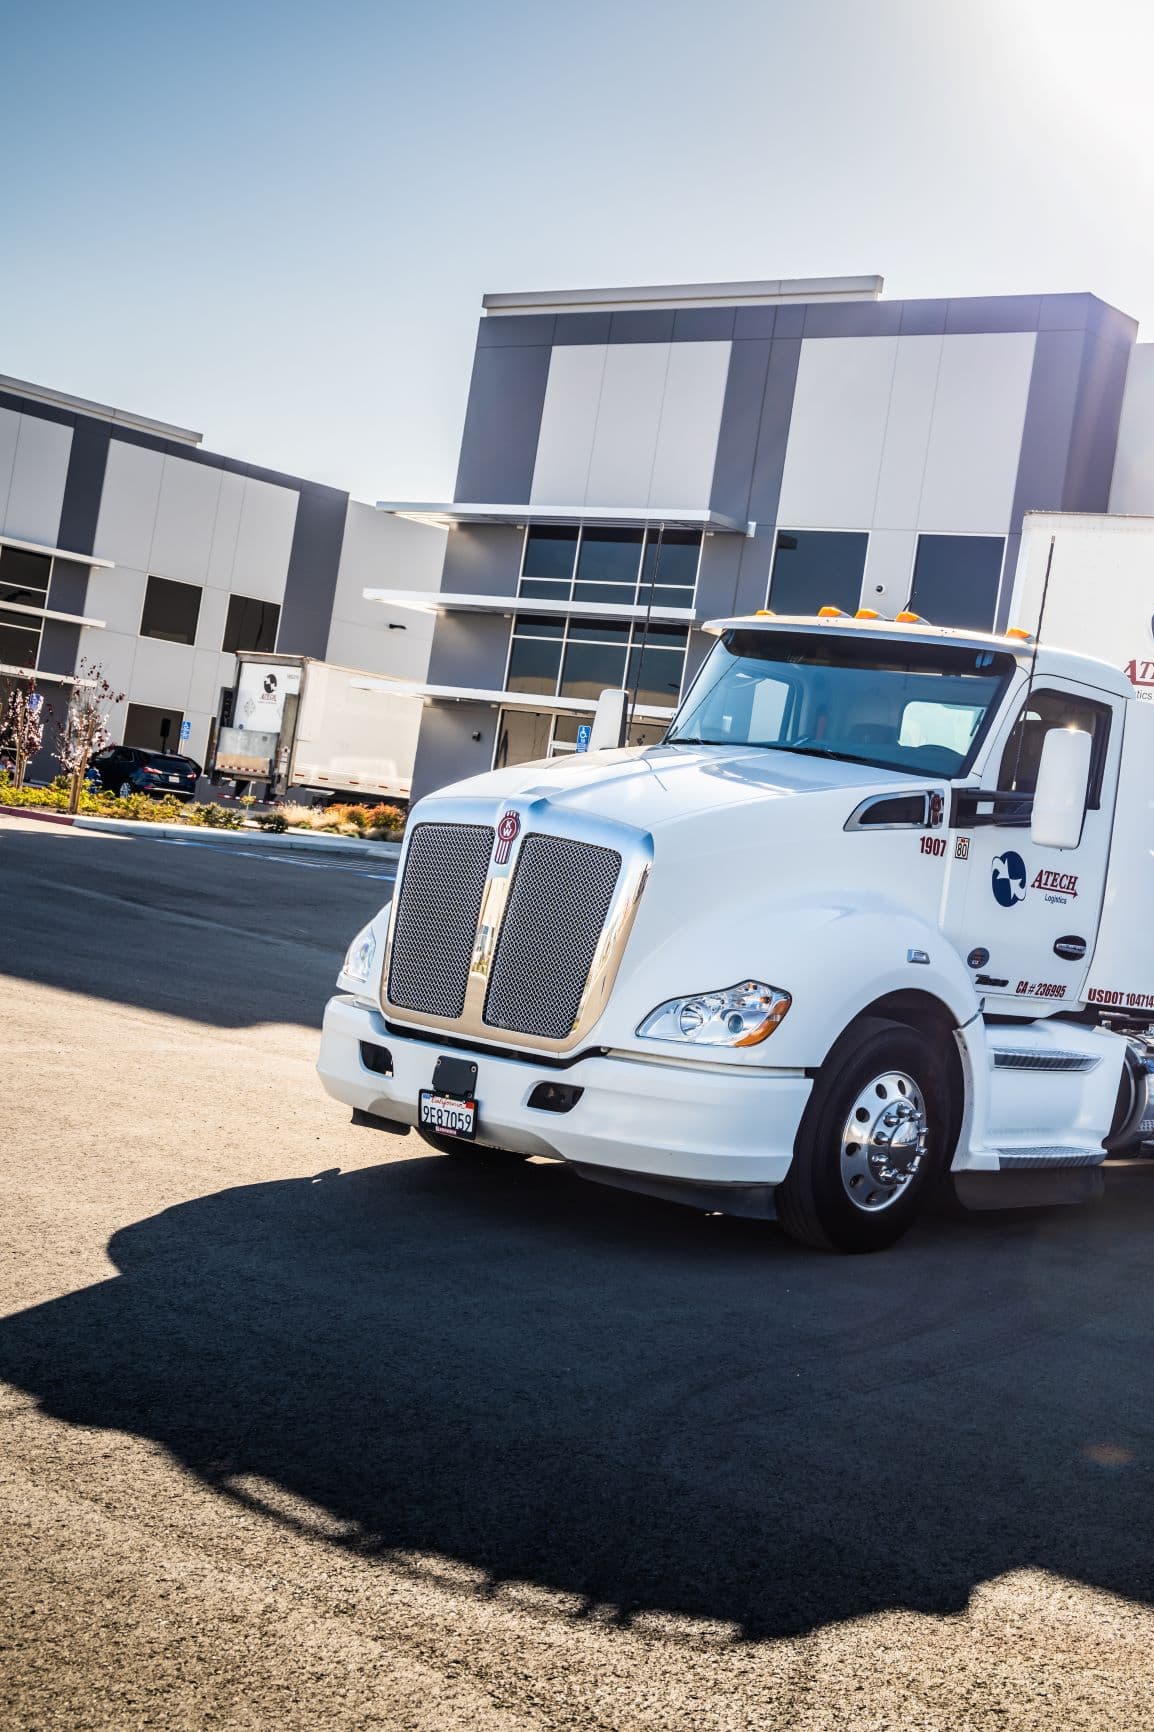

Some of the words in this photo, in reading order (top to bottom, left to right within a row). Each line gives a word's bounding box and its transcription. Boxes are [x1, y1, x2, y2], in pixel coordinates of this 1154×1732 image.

[920, 836, 946, 857] 1907
[956, 843, 967, 857] 80
[1030, 869, 1078, 891] ATECH
[1045, 894, 1067, 904] Logistics
[1035, 982, 1067, 998] 236995
[1087, 987, 1125, 1005] USDOT
